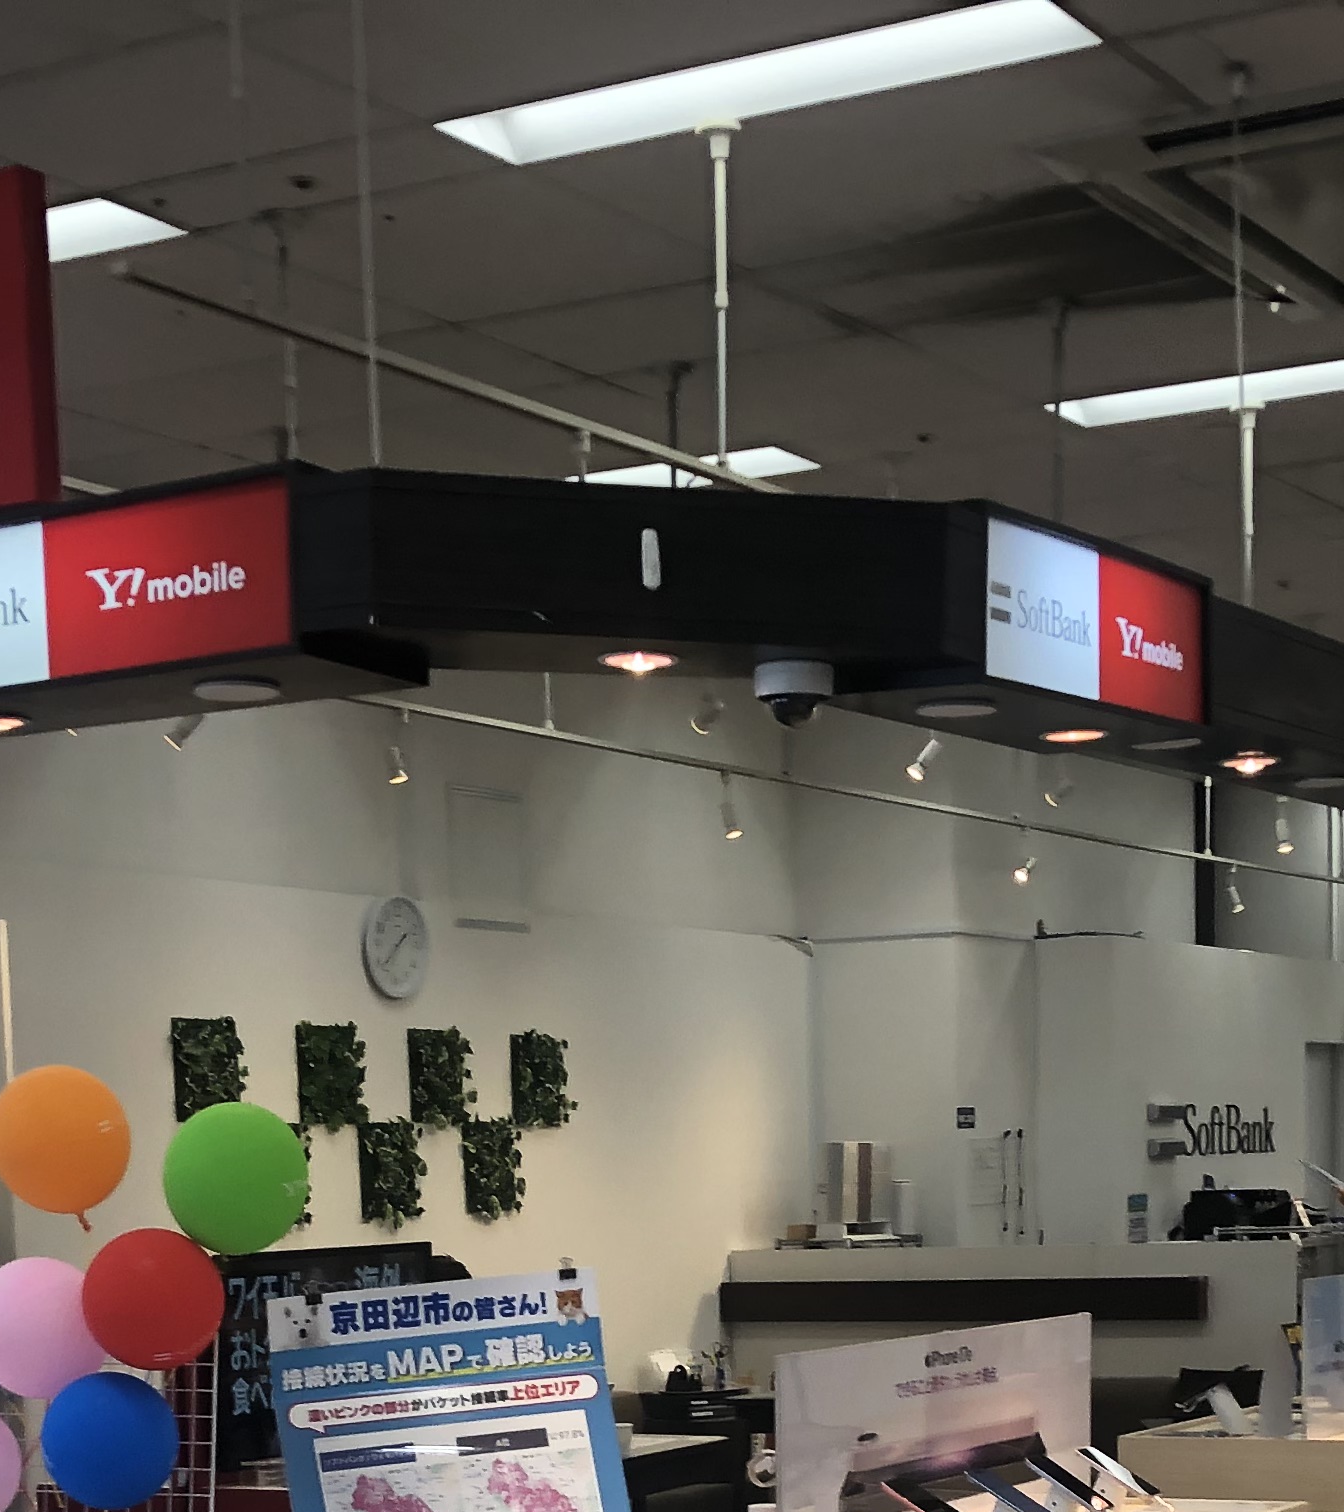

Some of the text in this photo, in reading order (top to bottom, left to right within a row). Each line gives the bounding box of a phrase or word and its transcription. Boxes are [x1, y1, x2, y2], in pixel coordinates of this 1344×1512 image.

[85, 559, 247, 612] Y!mobile
[1017, 589, 1184, 671] SoftBank Y!mobile
[1183, 1103, 1276, 1157] SoftBank
[329, 1291, 548, 1335] 京田辺市の皆さん!
